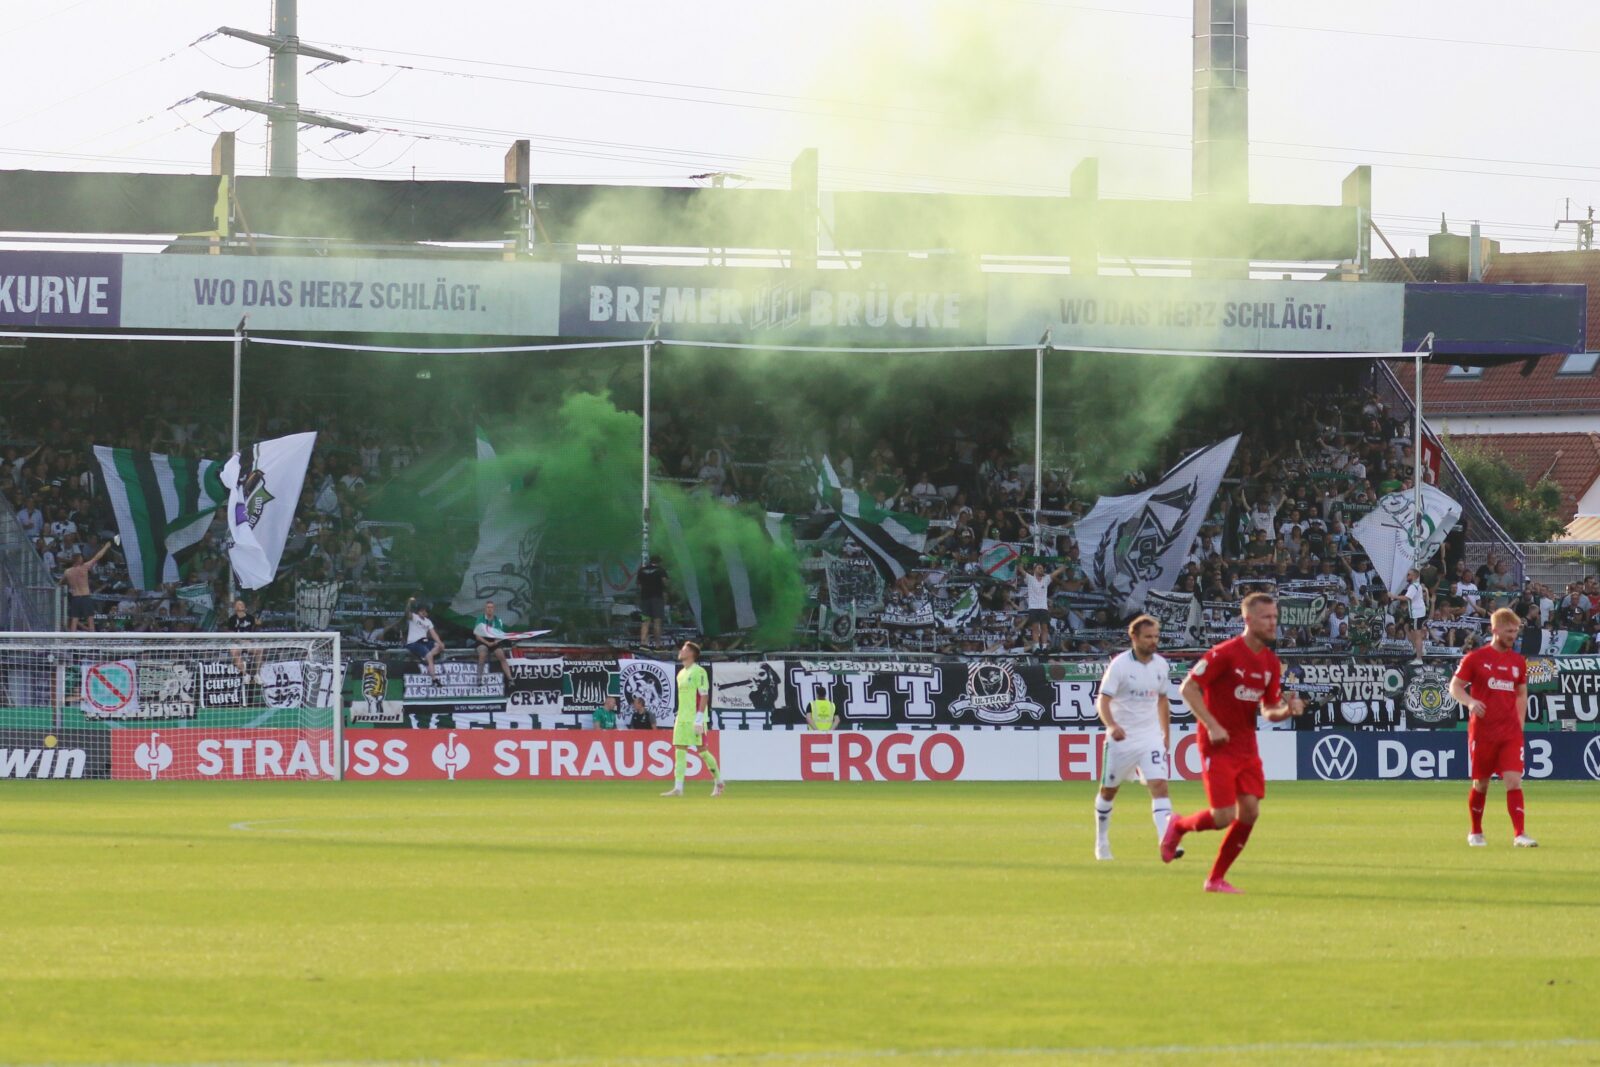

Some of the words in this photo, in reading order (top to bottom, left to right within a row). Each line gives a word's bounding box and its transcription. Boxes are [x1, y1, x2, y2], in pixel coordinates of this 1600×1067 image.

[0, 275, 109, 314] KURVE
[193, 277, 236, 305] WO
[242, 279, 292, 307] DAS
[300, 280, 363, 310] HERZ
[370, 277, 488, 313] SCHLÄGT.
[589, 284, 743, 325] BREMER
[808, 282, 962, 328] BRÜCKE
[1059, 298, 1096, 325] WO
[1102, 299, 1151, 327] DAS
[1158, 300, 1217, 328] HERZ
[1223, 297, 1333, 331] SCHLÄGT.
[509, 663, 562, 680] VITUS
[1300, 664, 1386, 683] BEGLEIT
[510, 690, 561, 706] CREW
[974, 695, 1008, 705] ULTRAS
[197, 739, 409, 776] STRAUSS
[800, 733, 965, 781] ERGO
[1377, 740, 1455, 778] Der
